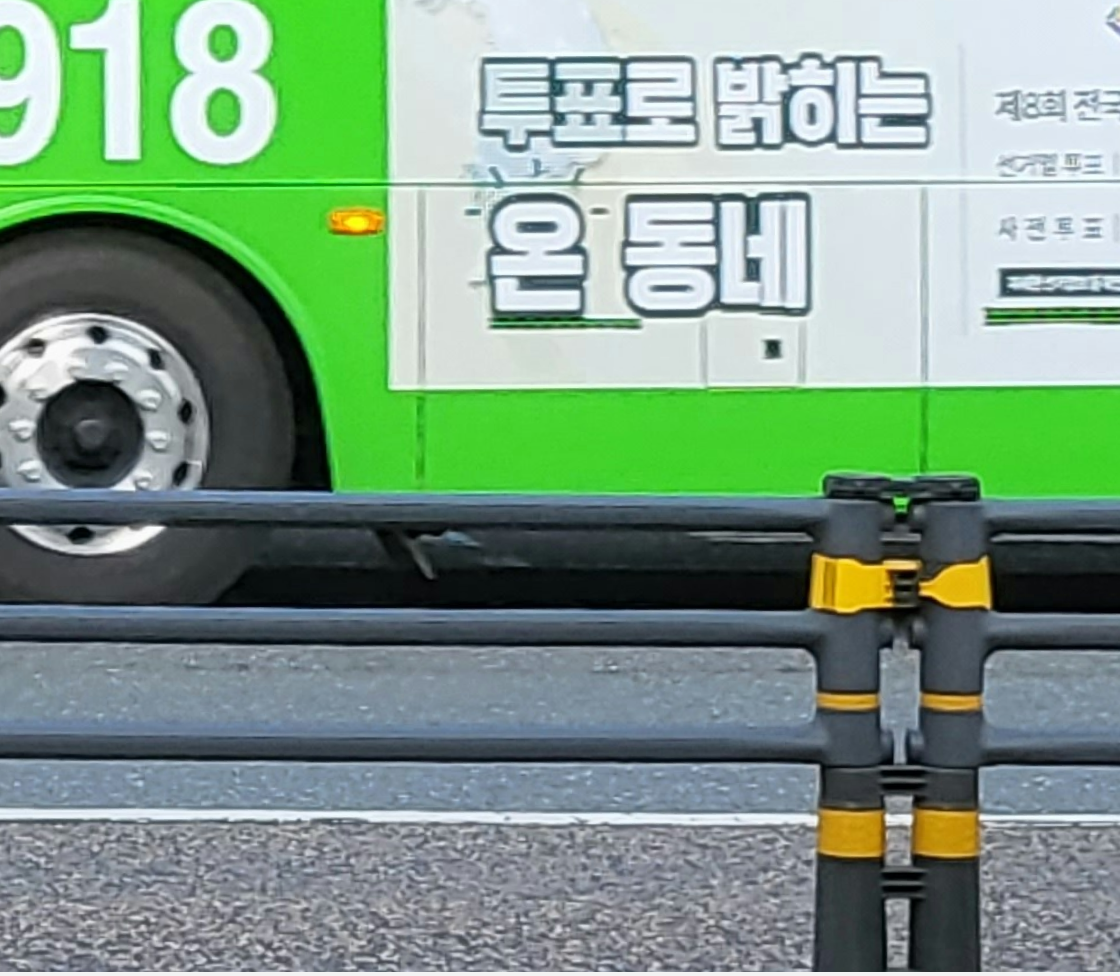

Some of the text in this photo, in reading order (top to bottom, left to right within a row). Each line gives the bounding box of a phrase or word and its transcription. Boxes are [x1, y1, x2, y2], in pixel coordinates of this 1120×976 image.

[479, 52, 933, 151] 투표로 밝히는
[994, 89, 1067, 122] 제8회
[486, 192, 812, 318] 온 동네
